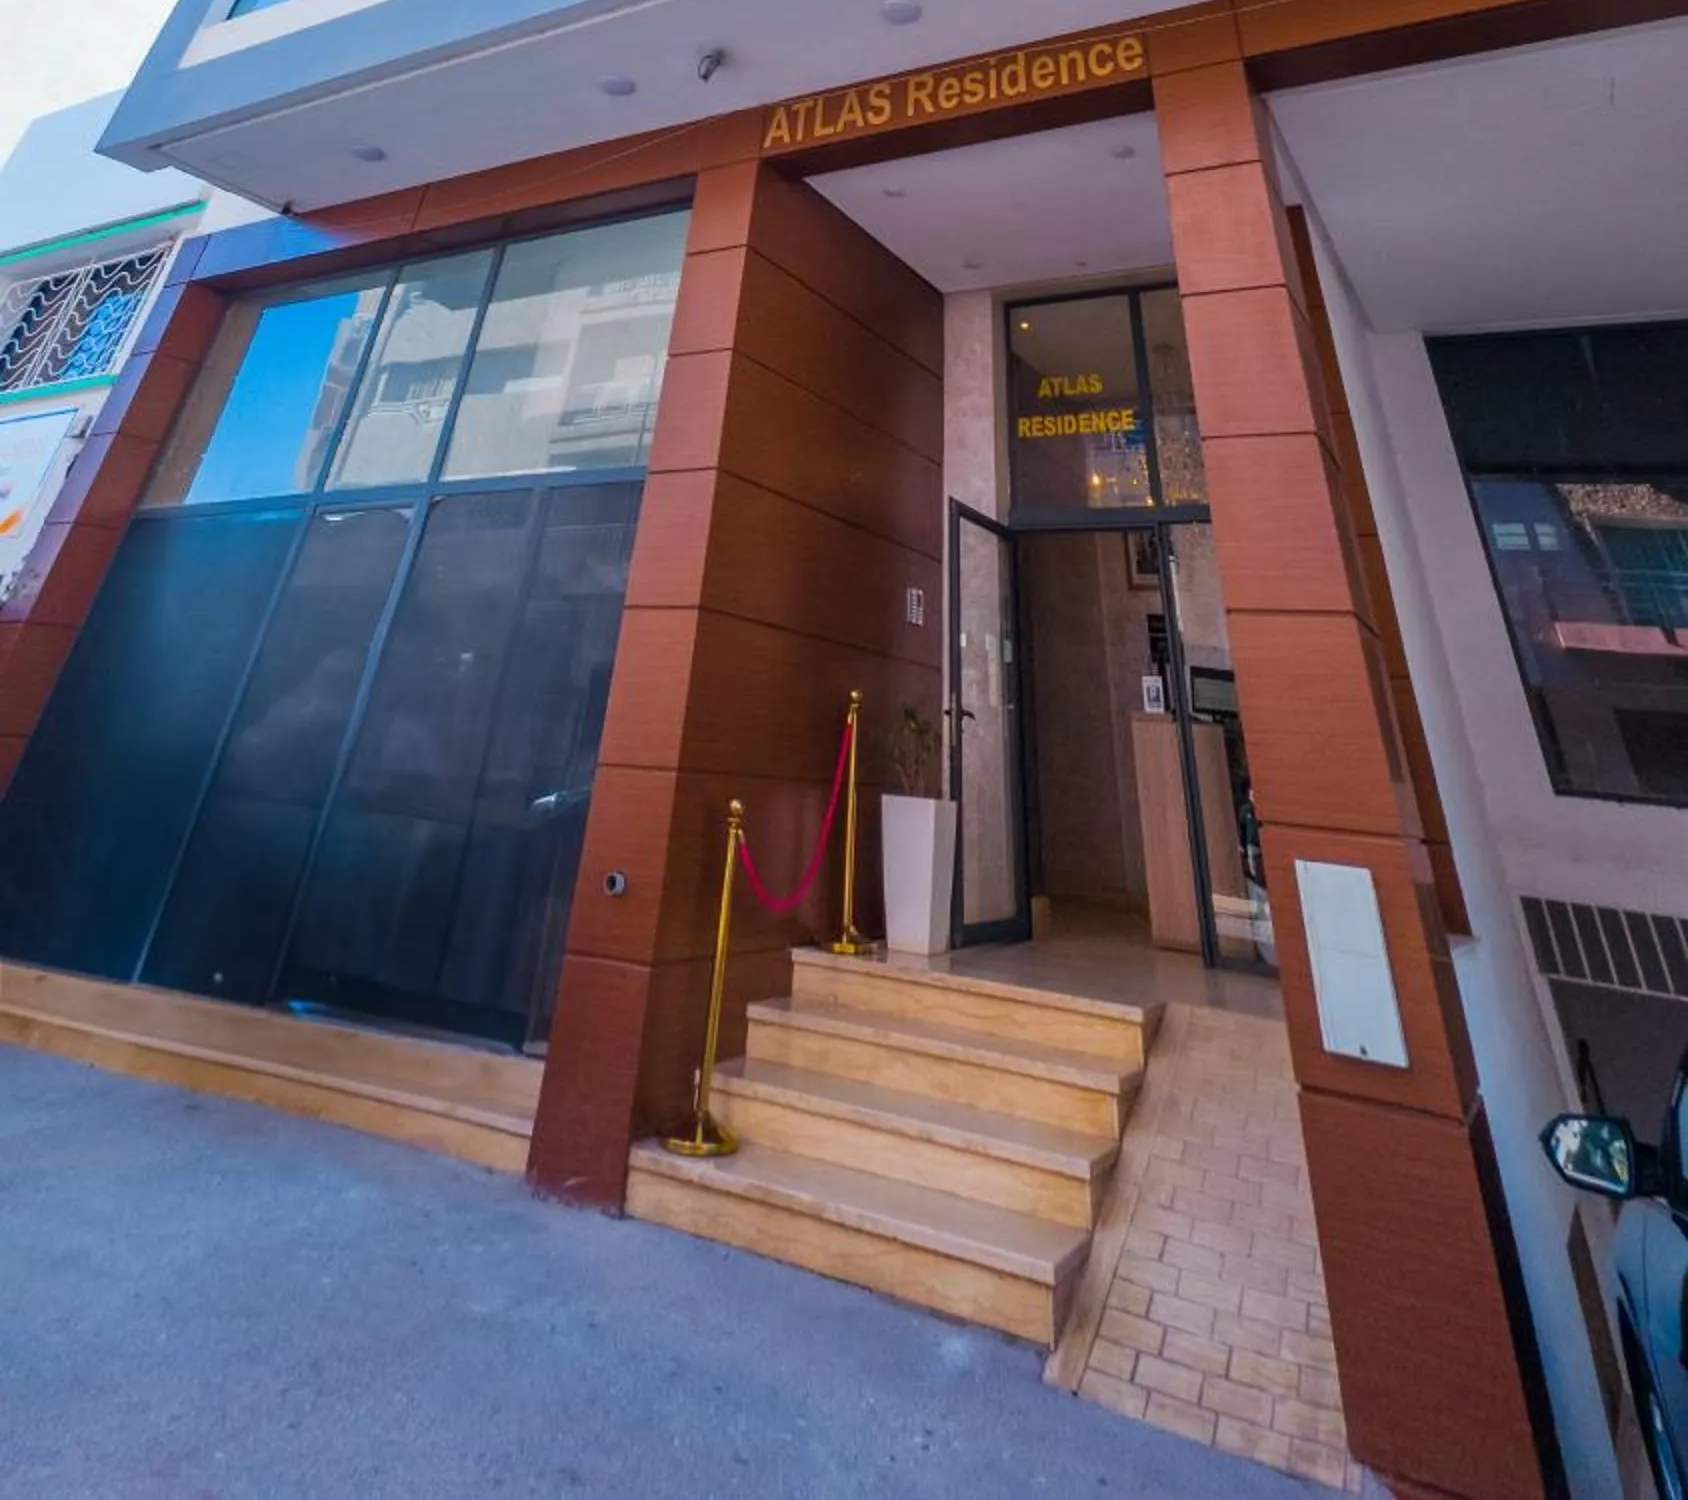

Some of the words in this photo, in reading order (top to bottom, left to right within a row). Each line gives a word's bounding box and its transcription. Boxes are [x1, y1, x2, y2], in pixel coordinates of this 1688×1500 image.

[763, 81, 892, 148] ATLAS
[906, 37, 1144, 117] Residence
[1038, 373, 1103, 398] ATLAS
[1018, 409, 1135, 438] RESIDENCE
